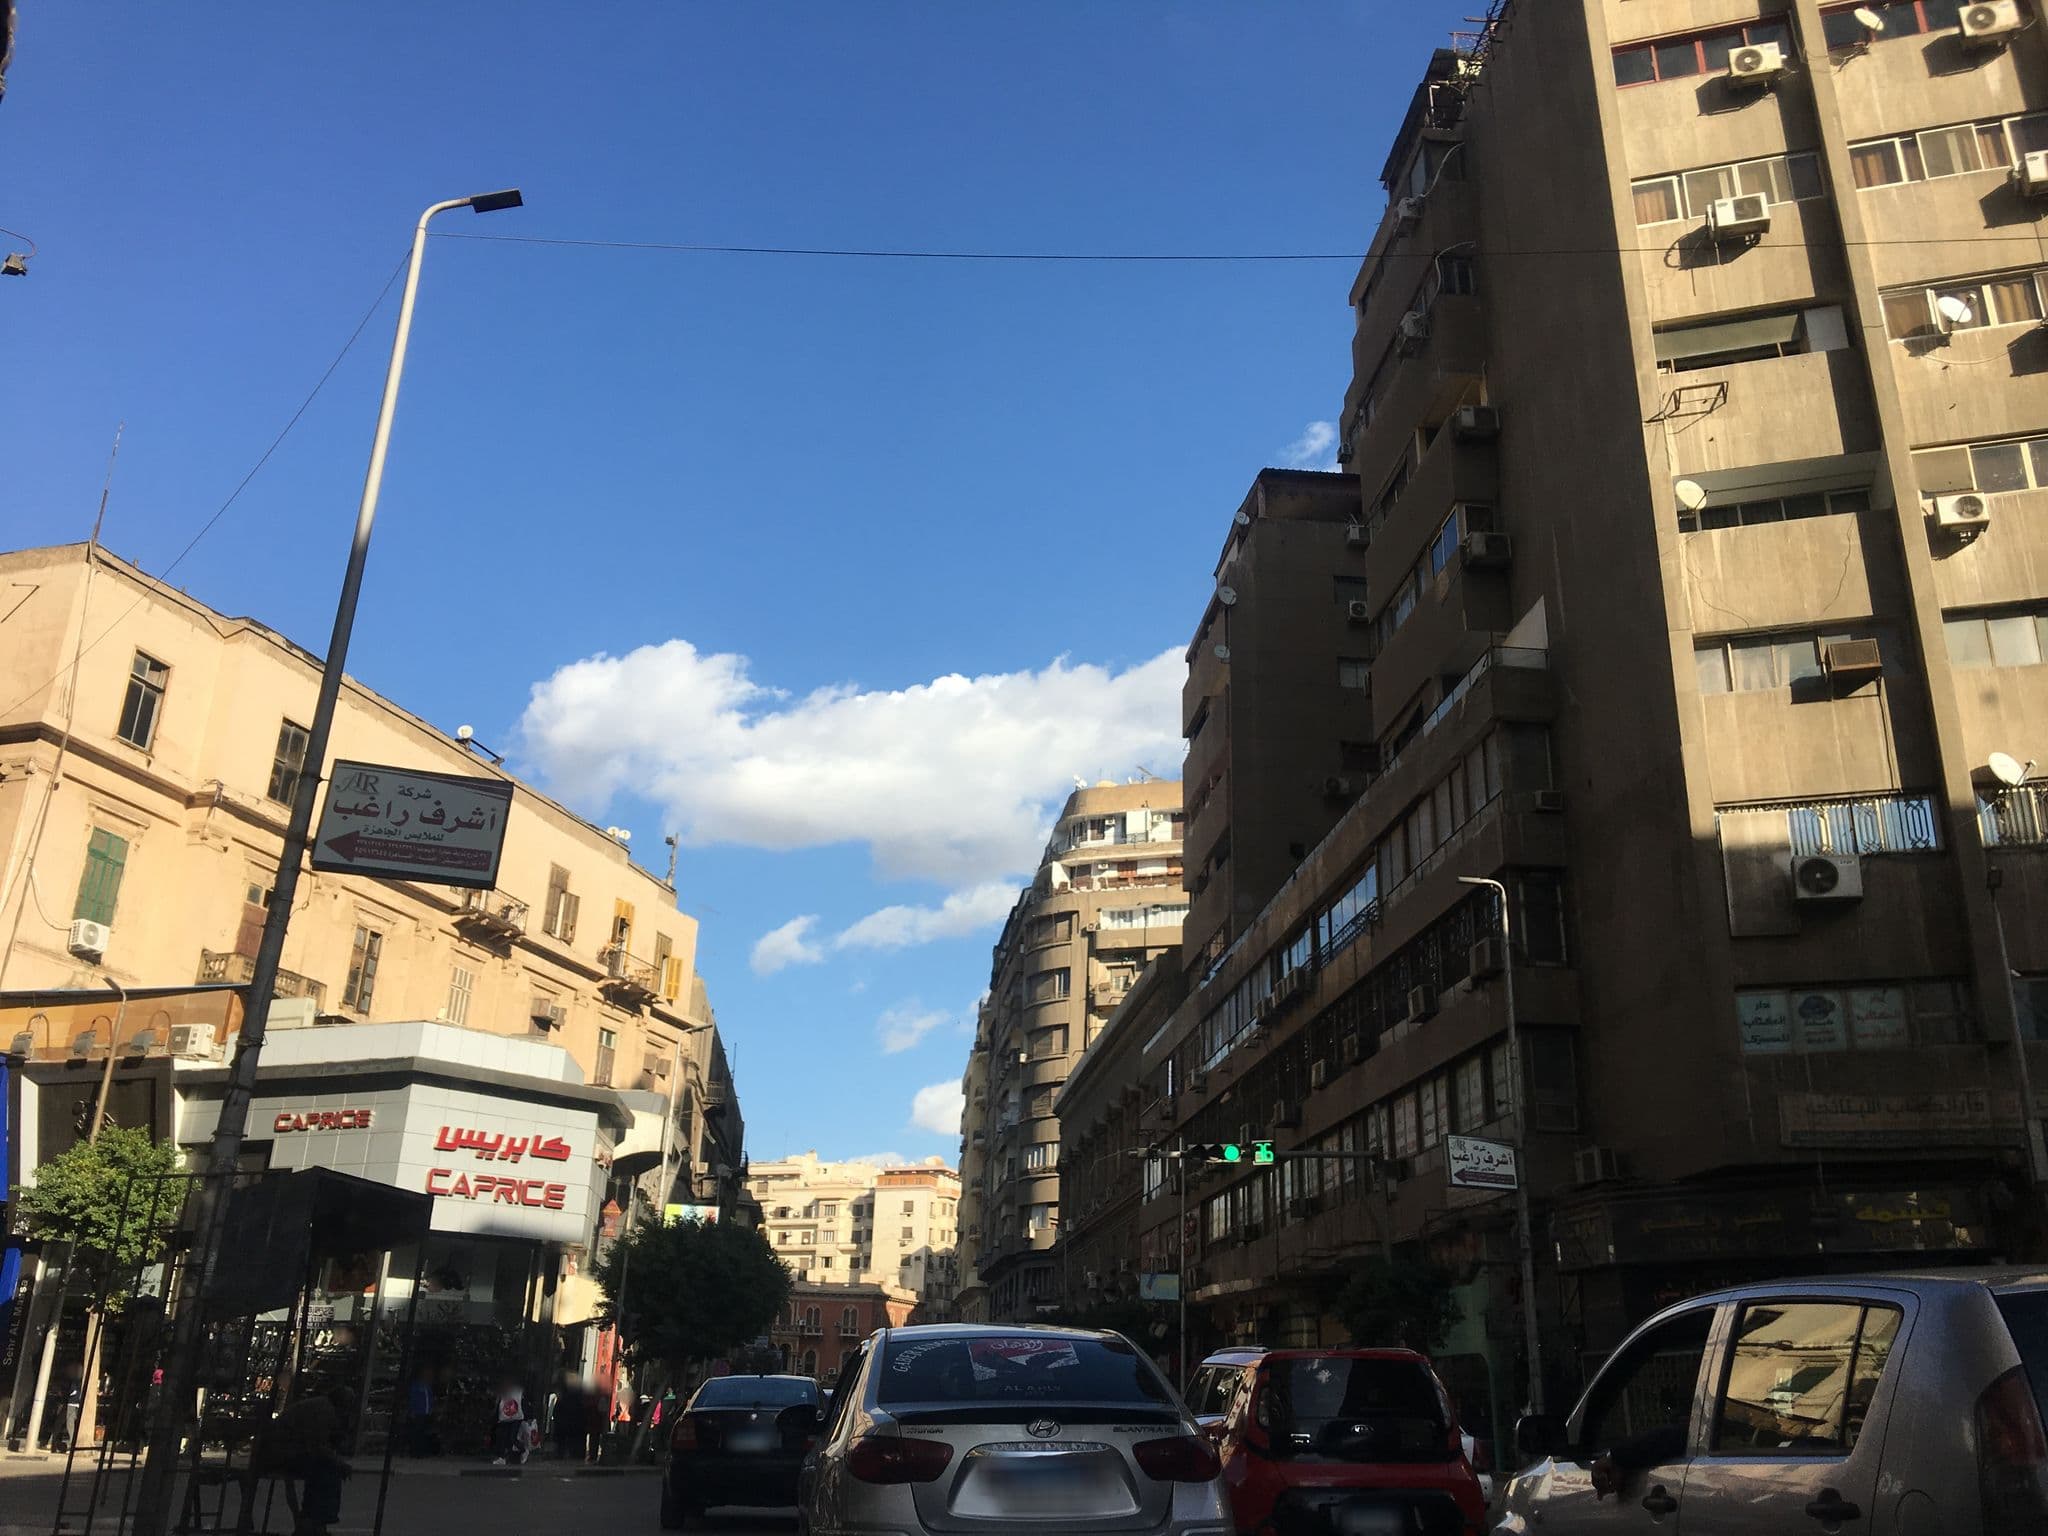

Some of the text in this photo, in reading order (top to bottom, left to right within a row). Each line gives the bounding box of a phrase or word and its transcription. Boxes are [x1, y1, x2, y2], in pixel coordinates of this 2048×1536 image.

[397, 783, 433, 801] شركة
[332, 795, 496, 834] أشرف راغب
[362, 823, 403, 840] الجاهزة
[273, 1109, 371, 1133] CAPRICE
[433, 1125, 572, 1164] كابريس
[1452, 1150, 1513, 1168] أشرف راغب
[425, 1168, 568, 1210] CAPRICE
